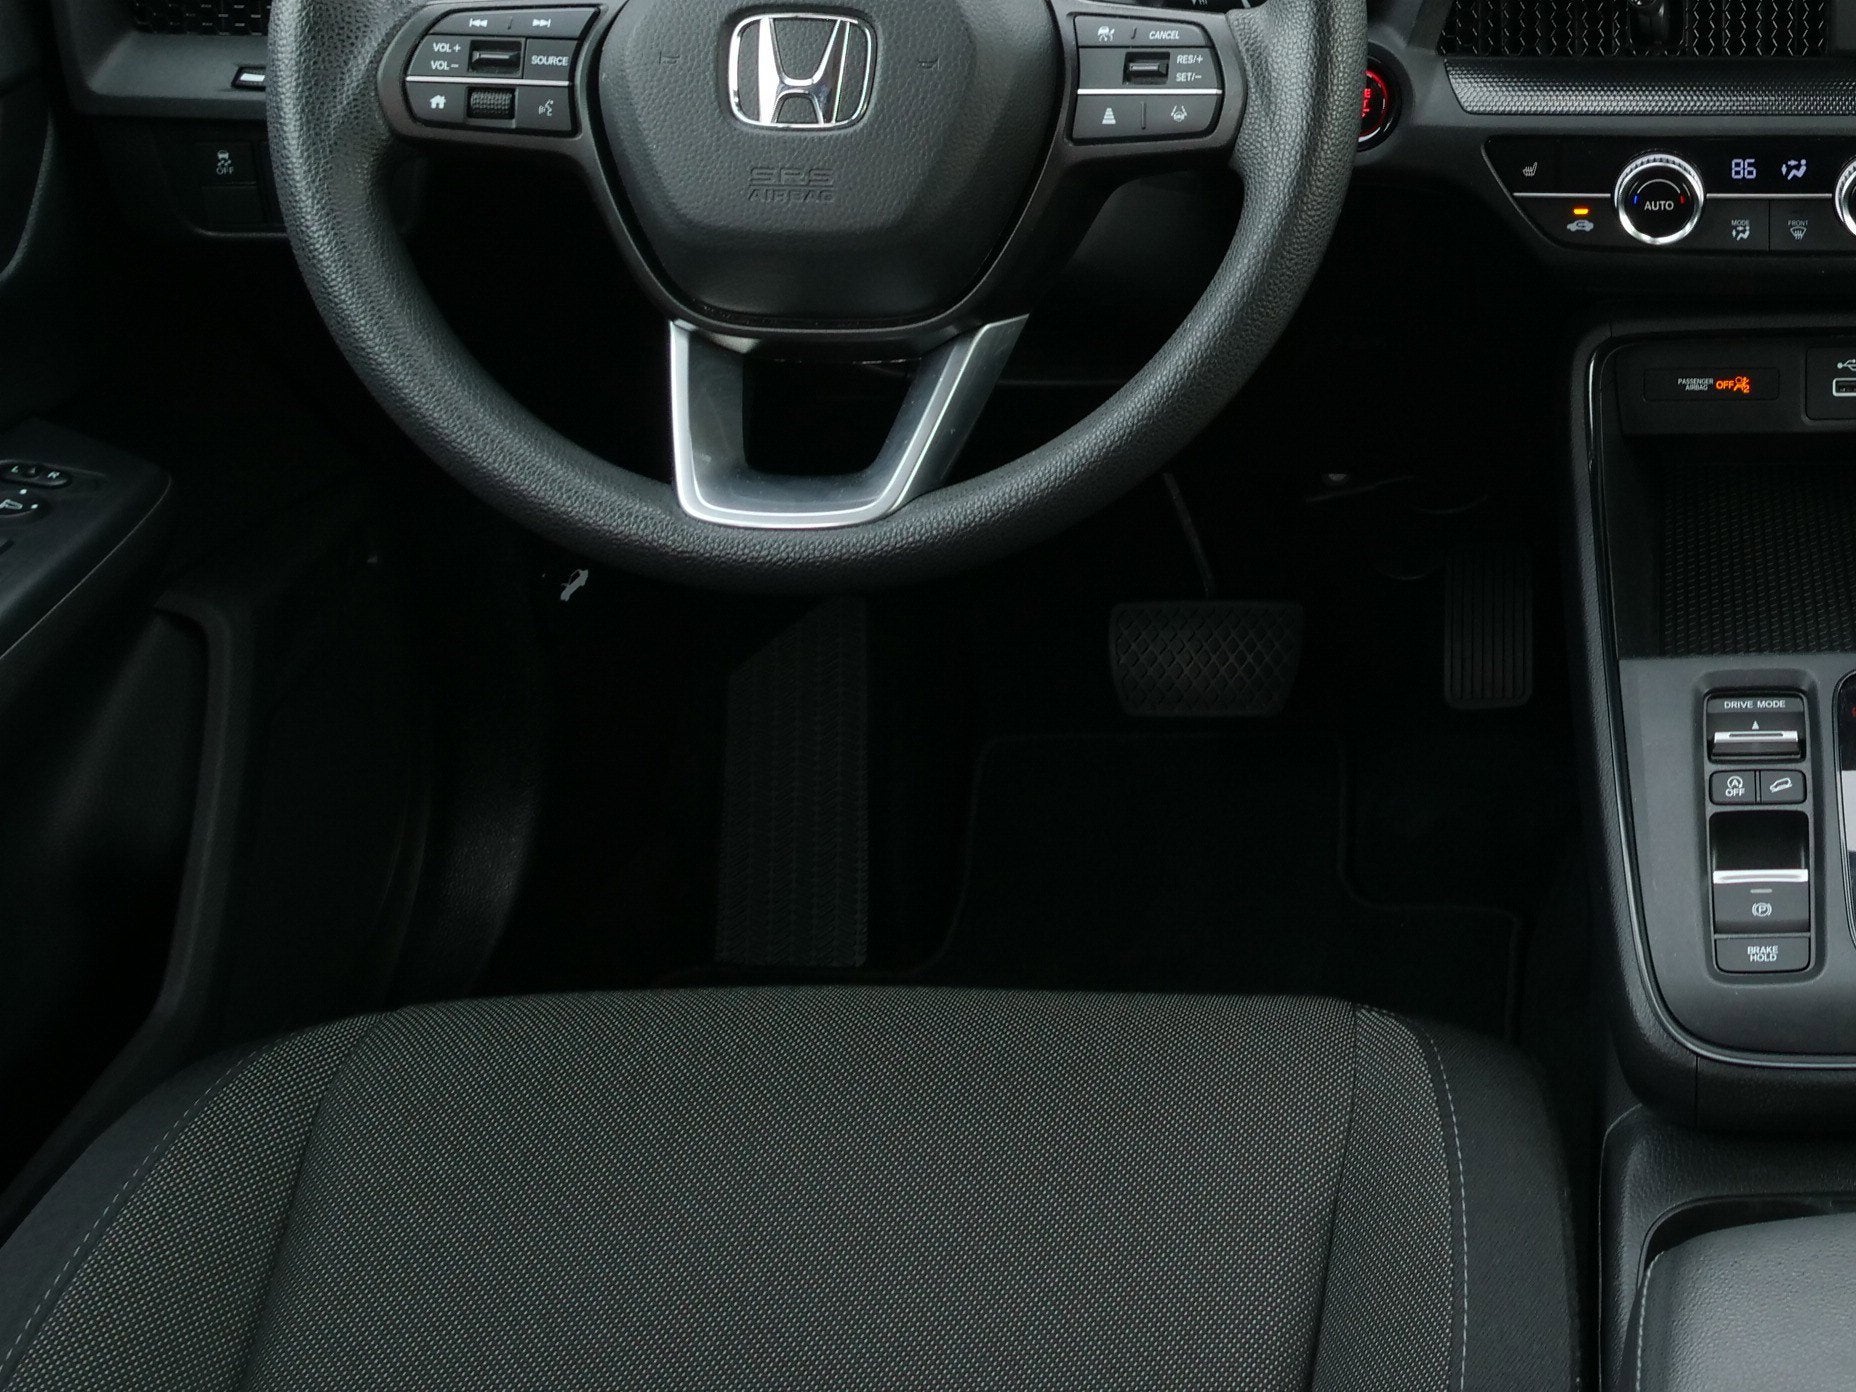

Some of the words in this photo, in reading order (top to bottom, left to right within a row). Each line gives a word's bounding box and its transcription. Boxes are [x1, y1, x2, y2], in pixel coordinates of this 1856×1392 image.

[1149, 29, 1181, 40] CANCEL
[432, 42, 451, 53] VOL
[430, 60, 450, 71] VOL
[531, 55, 569, 66] SOURCE
[216, 165, 235, 175] OFF
[1731, 158, 1757, 180] 86
[748, 166, 834, 185] SRS
[748, 188, 834, 204] AIRBAG
[1644, 200, 1675, 211] AUTO
[1731, 219, 1751, 227] MODE
[1787, 219, 1809, 227] FRONT
[1677, 377, 1714, 385] PASSENGER
[1715, 380, 1735, 390] OFF
[1724, 700, 1755, 709] DRIVE
[1756, 699, 1786, 708] MODE
[1725, 787, 1746, 797] OFF
[1747, 945, 1779, 954] BRAKE
[1749, 953, 1778, 963] HOLD
